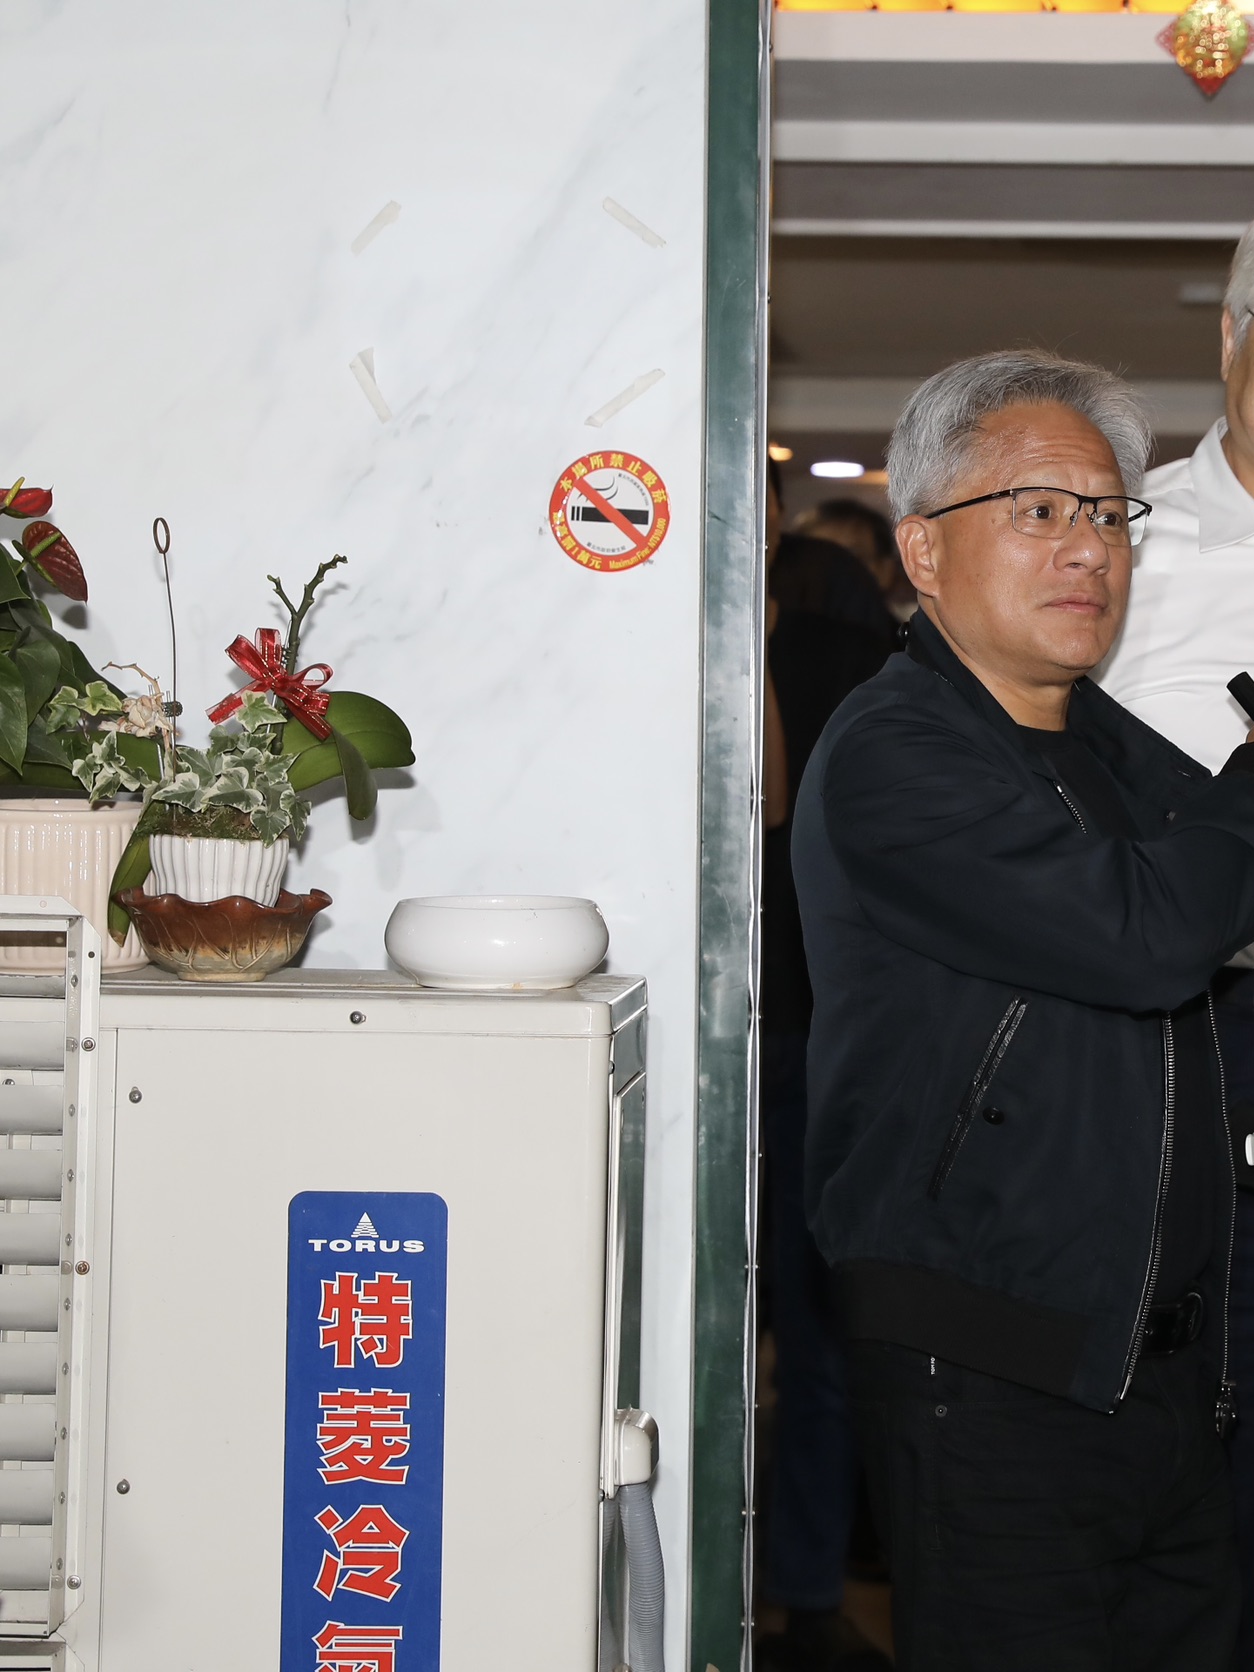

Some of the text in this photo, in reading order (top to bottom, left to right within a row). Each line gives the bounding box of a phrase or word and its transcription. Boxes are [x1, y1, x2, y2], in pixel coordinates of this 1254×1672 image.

[560, 453, 667, 503] 本場所禁止吸菸
[308, 1239, 426, 1253] TORUS
[312, 1271, 413, 1672] 特菱冷氣
